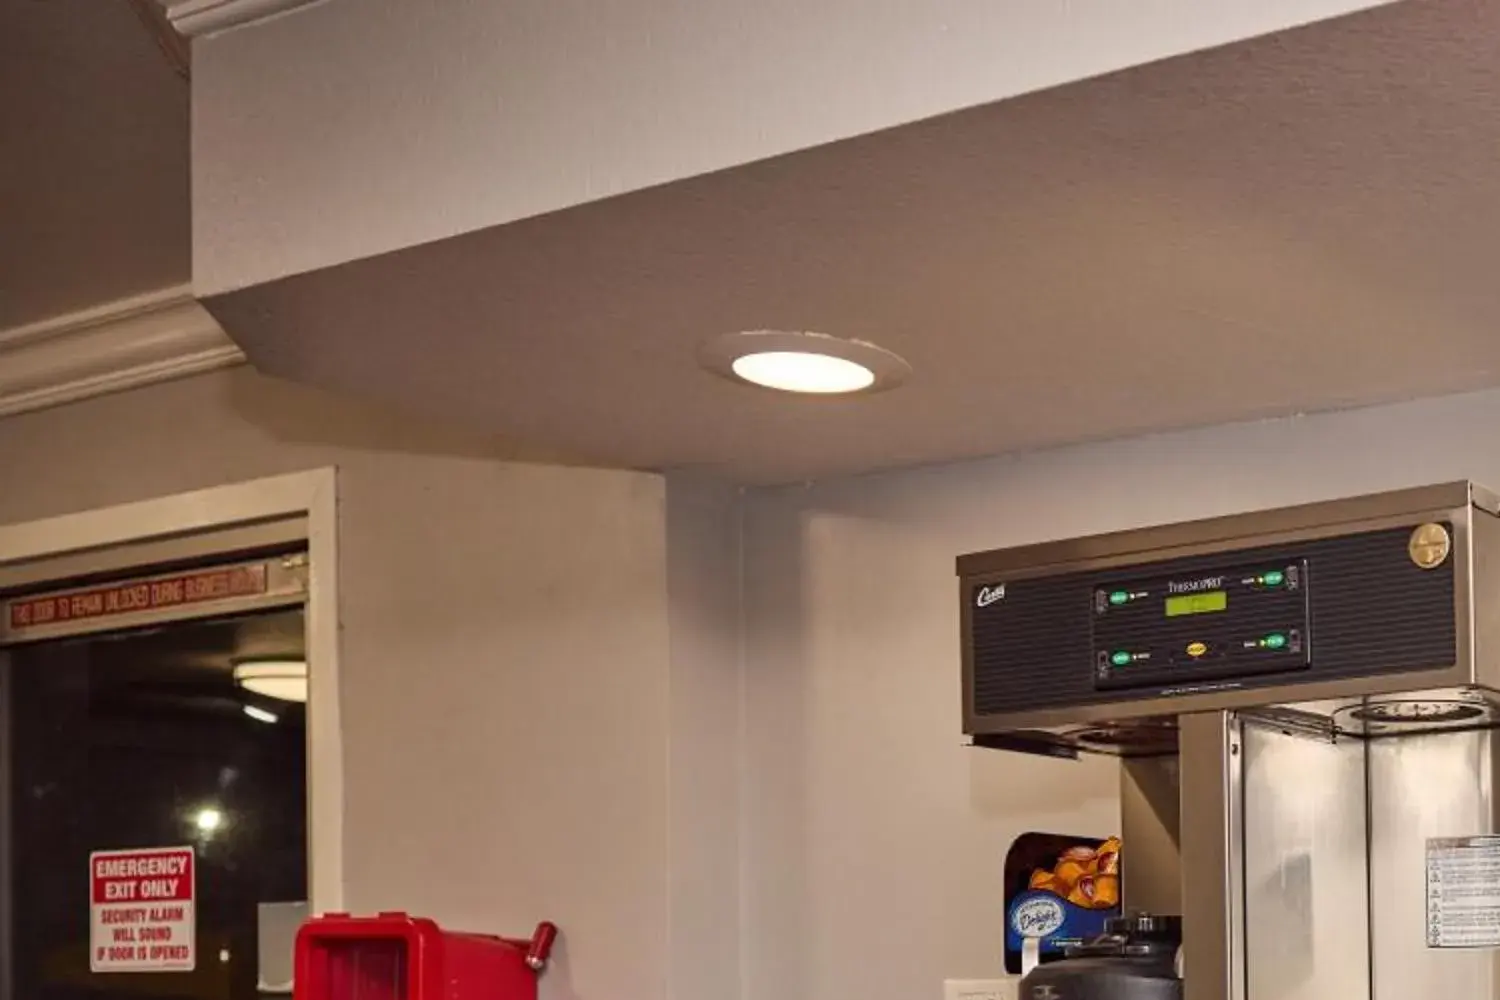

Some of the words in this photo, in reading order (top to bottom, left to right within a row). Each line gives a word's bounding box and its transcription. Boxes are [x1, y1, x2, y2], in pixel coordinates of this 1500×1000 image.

[96, 856, 187, 878] EMERGENCY
[105, 881, 137, 899] EXIT
[141, 879, 178, 898] ONLY
[101, 908, 146, 924] SECURITY
[149, 907, 183, 921] ALARM
[113, 927, 135, 941] WILL
[139, 926, 171, 941] SOUND
[150, 944, 188, 959] OPENED
